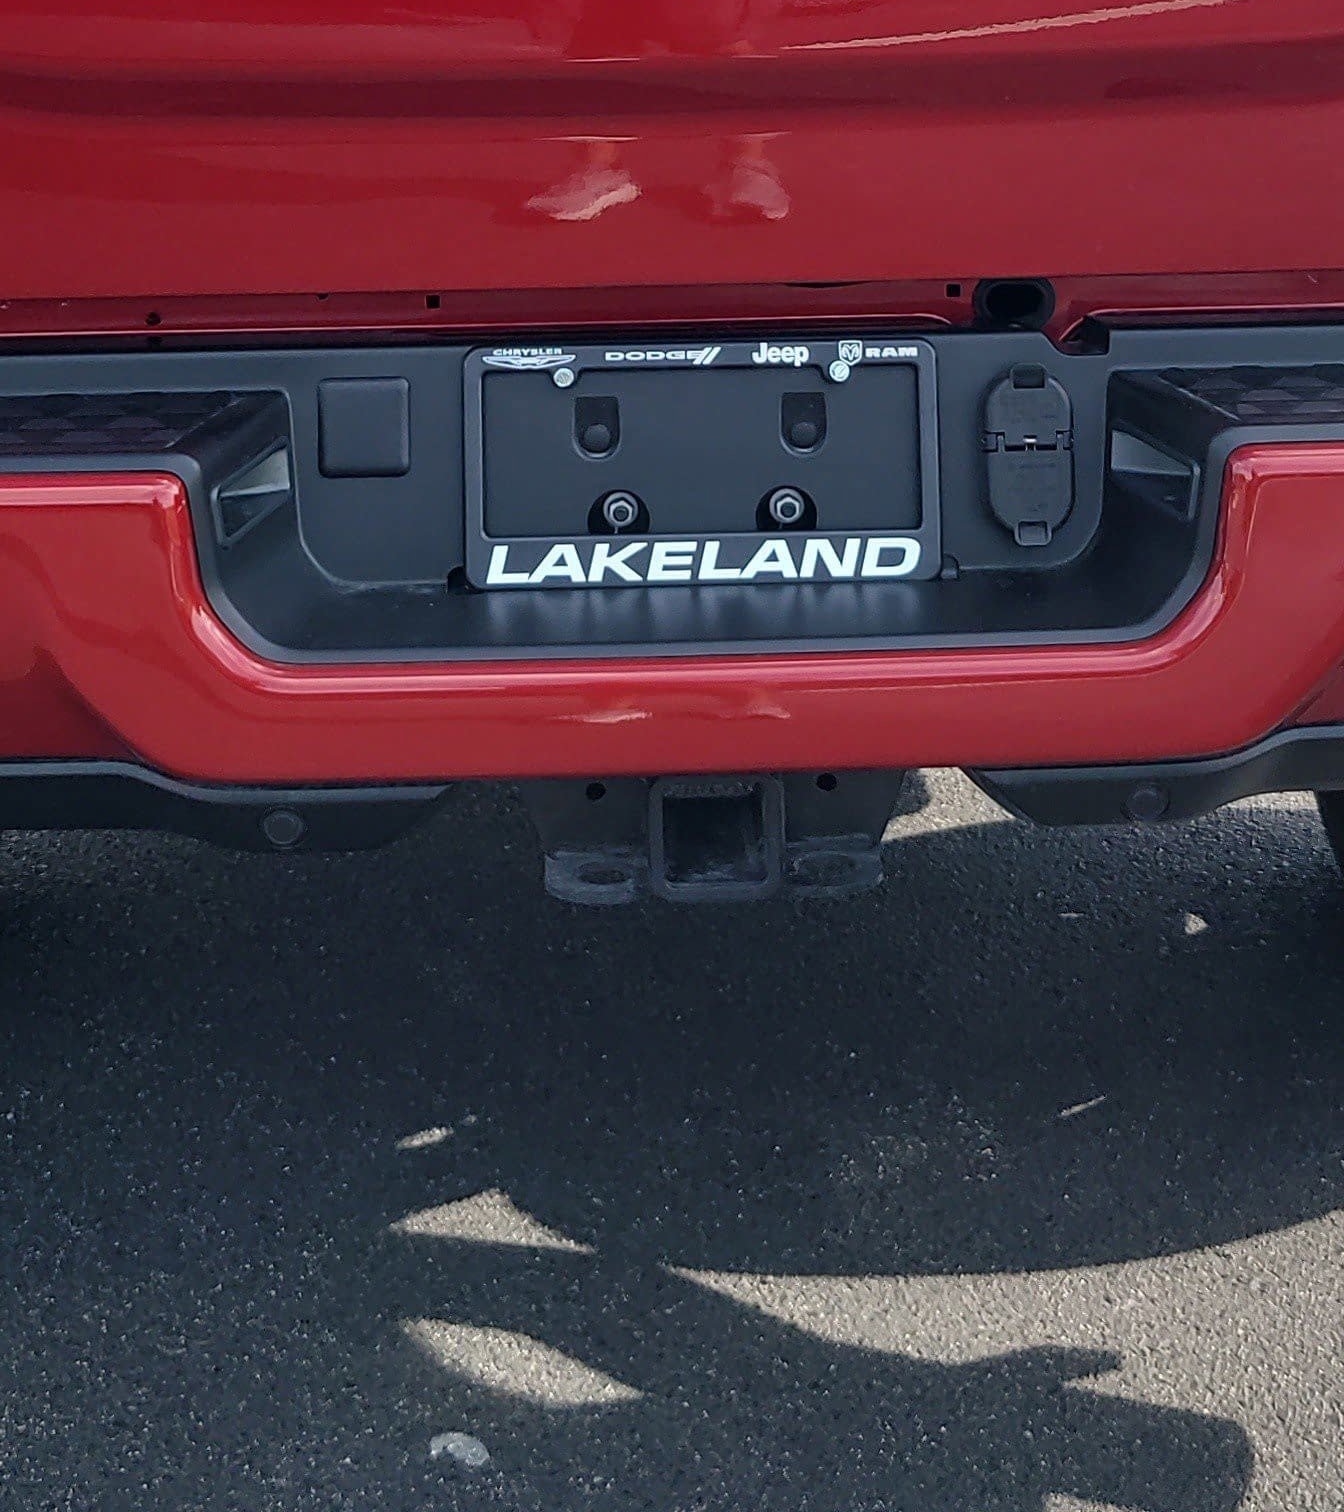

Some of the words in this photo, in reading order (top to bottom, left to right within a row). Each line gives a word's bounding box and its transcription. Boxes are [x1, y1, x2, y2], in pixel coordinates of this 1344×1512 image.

[492, 348, 563, 356] CHRYSLER
[605, 349, 703, 362] DODGE
[752, 341, 810, 367] Jeep
[864, 346, 918, 358] RAM
[485, 536, 922, 586] LAKELAND
